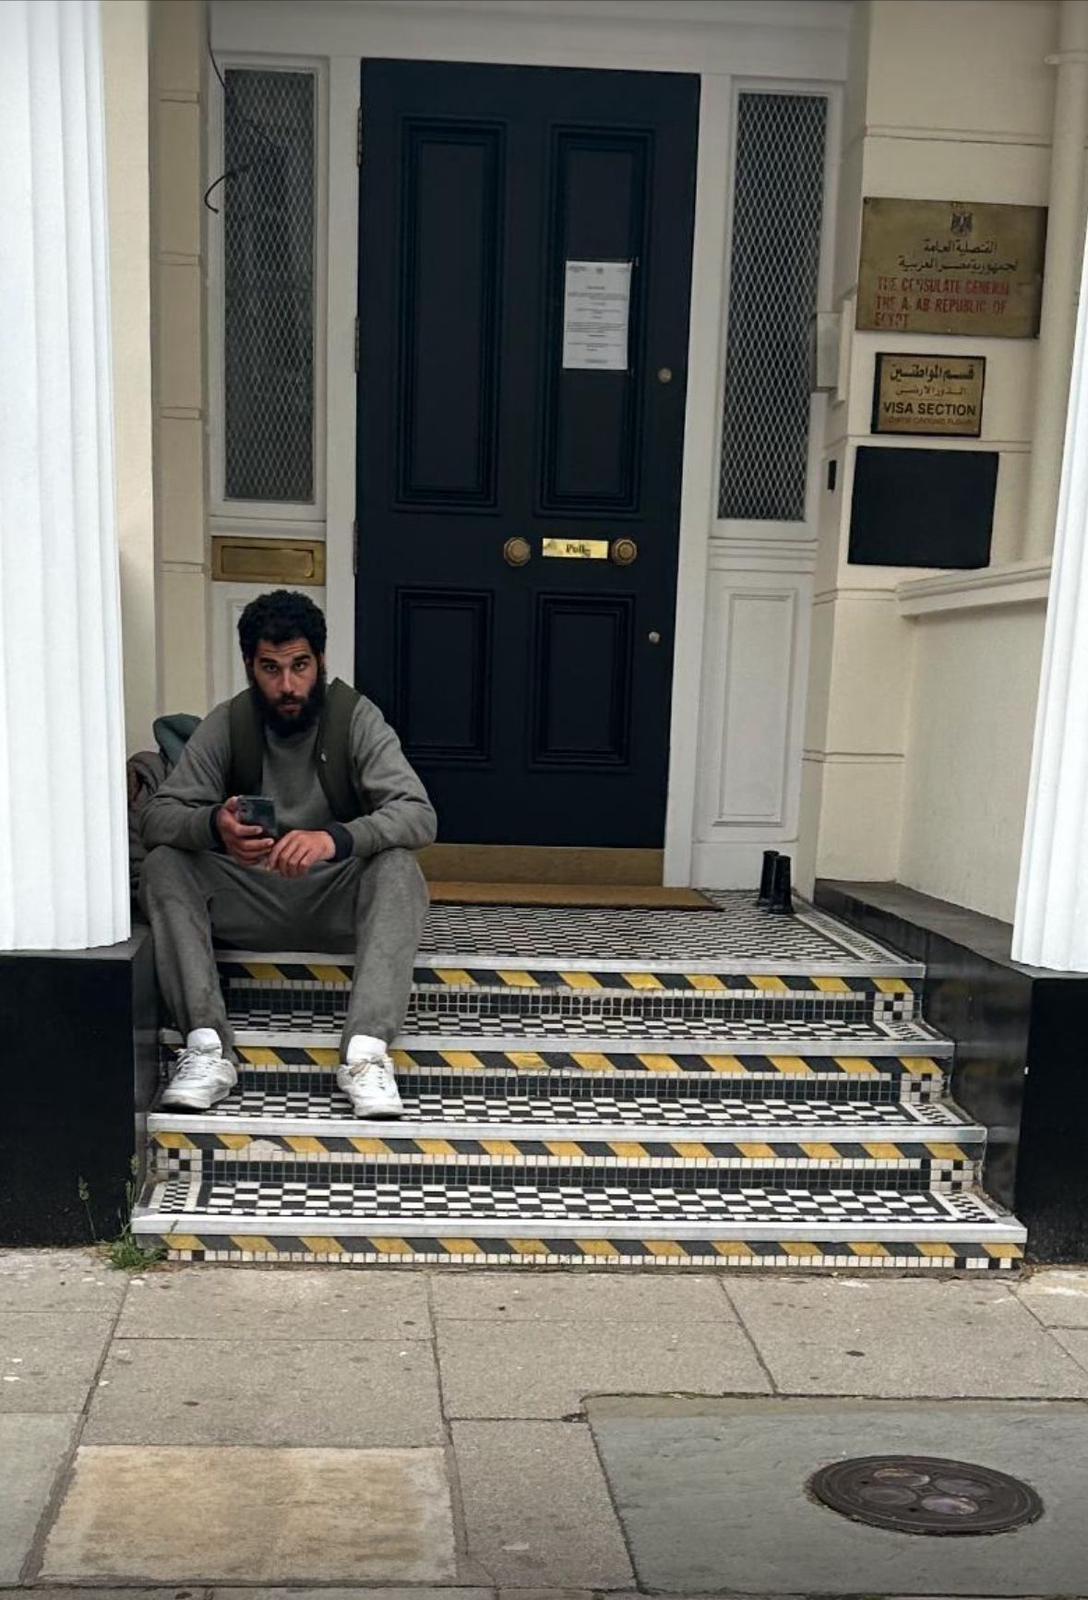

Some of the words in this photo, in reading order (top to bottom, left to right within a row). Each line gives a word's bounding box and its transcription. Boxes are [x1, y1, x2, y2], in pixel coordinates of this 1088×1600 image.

[896, 255, 937, 272] العربية
[943, 364, 975, 382] قسم
[884, 402, 914, 414] VISA
[917, 403, 976, 416] SECTION
